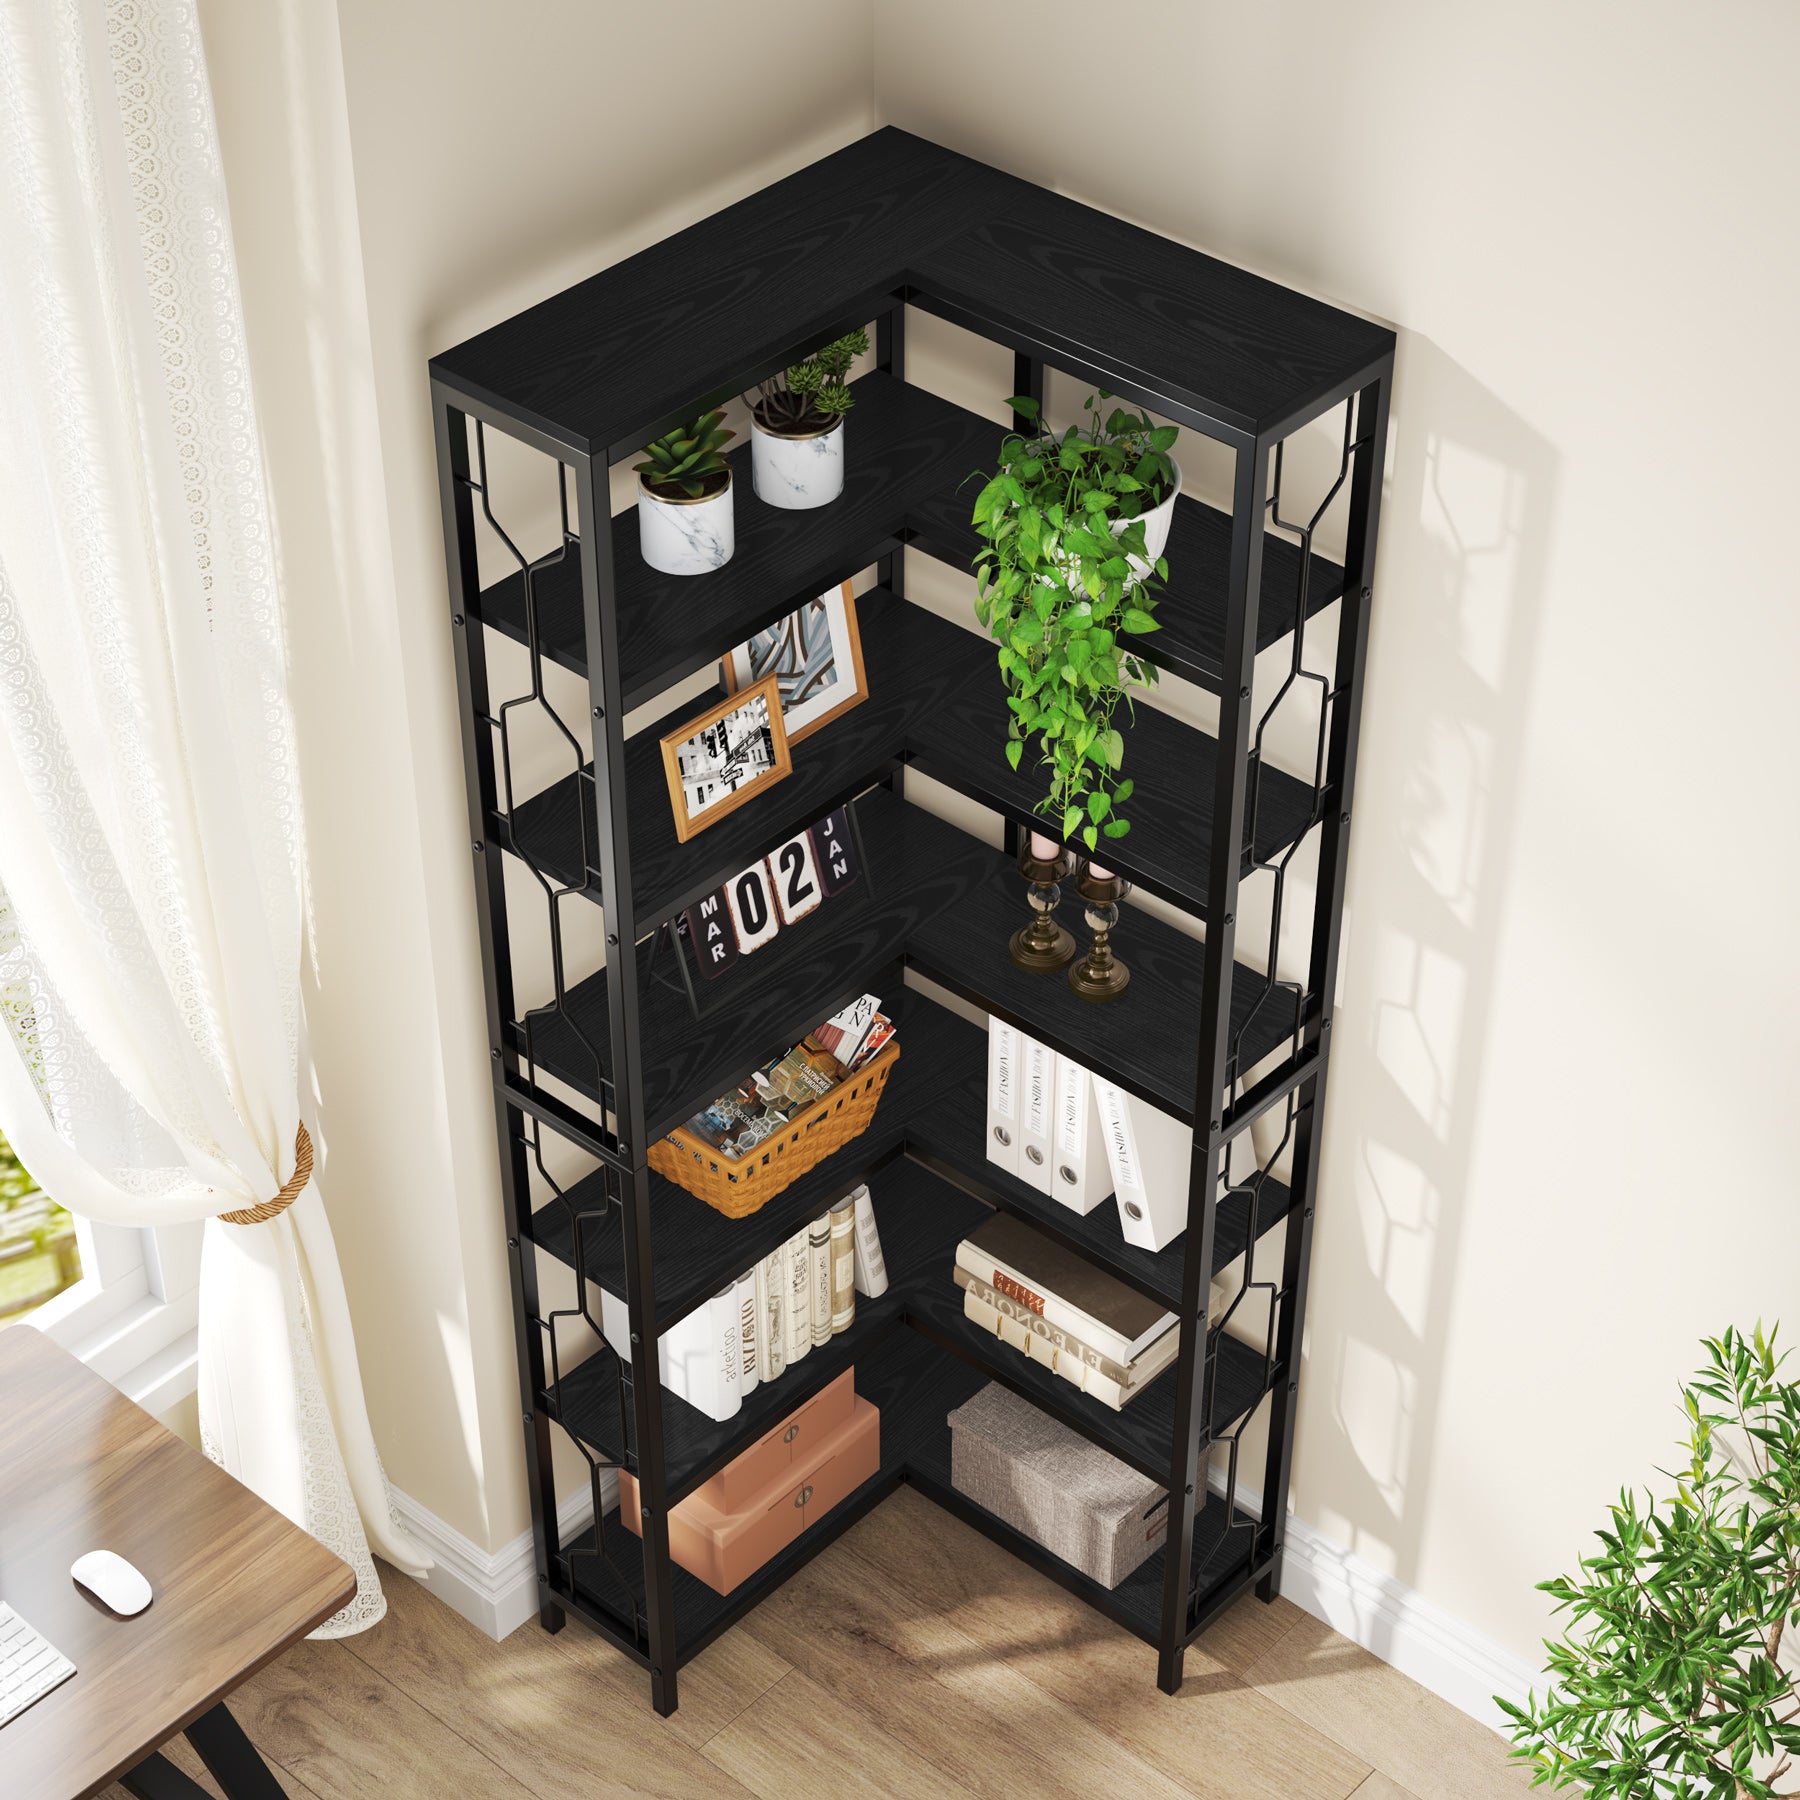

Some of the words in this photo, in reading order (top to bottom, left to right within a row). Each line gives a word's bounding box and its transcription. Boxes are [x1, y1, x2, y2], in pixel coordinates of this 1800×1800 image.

[823, 817, 848, 880] JAN
[700, 896, 726, 963] MAR
[999, 1056, 1009, 1095] FASHION
[1031, 1075, 1042, 1115] FASHION
[1065, 1095, 1076, 1134] FASHION
[1112, 1121, 1129, 1164] FASHION
